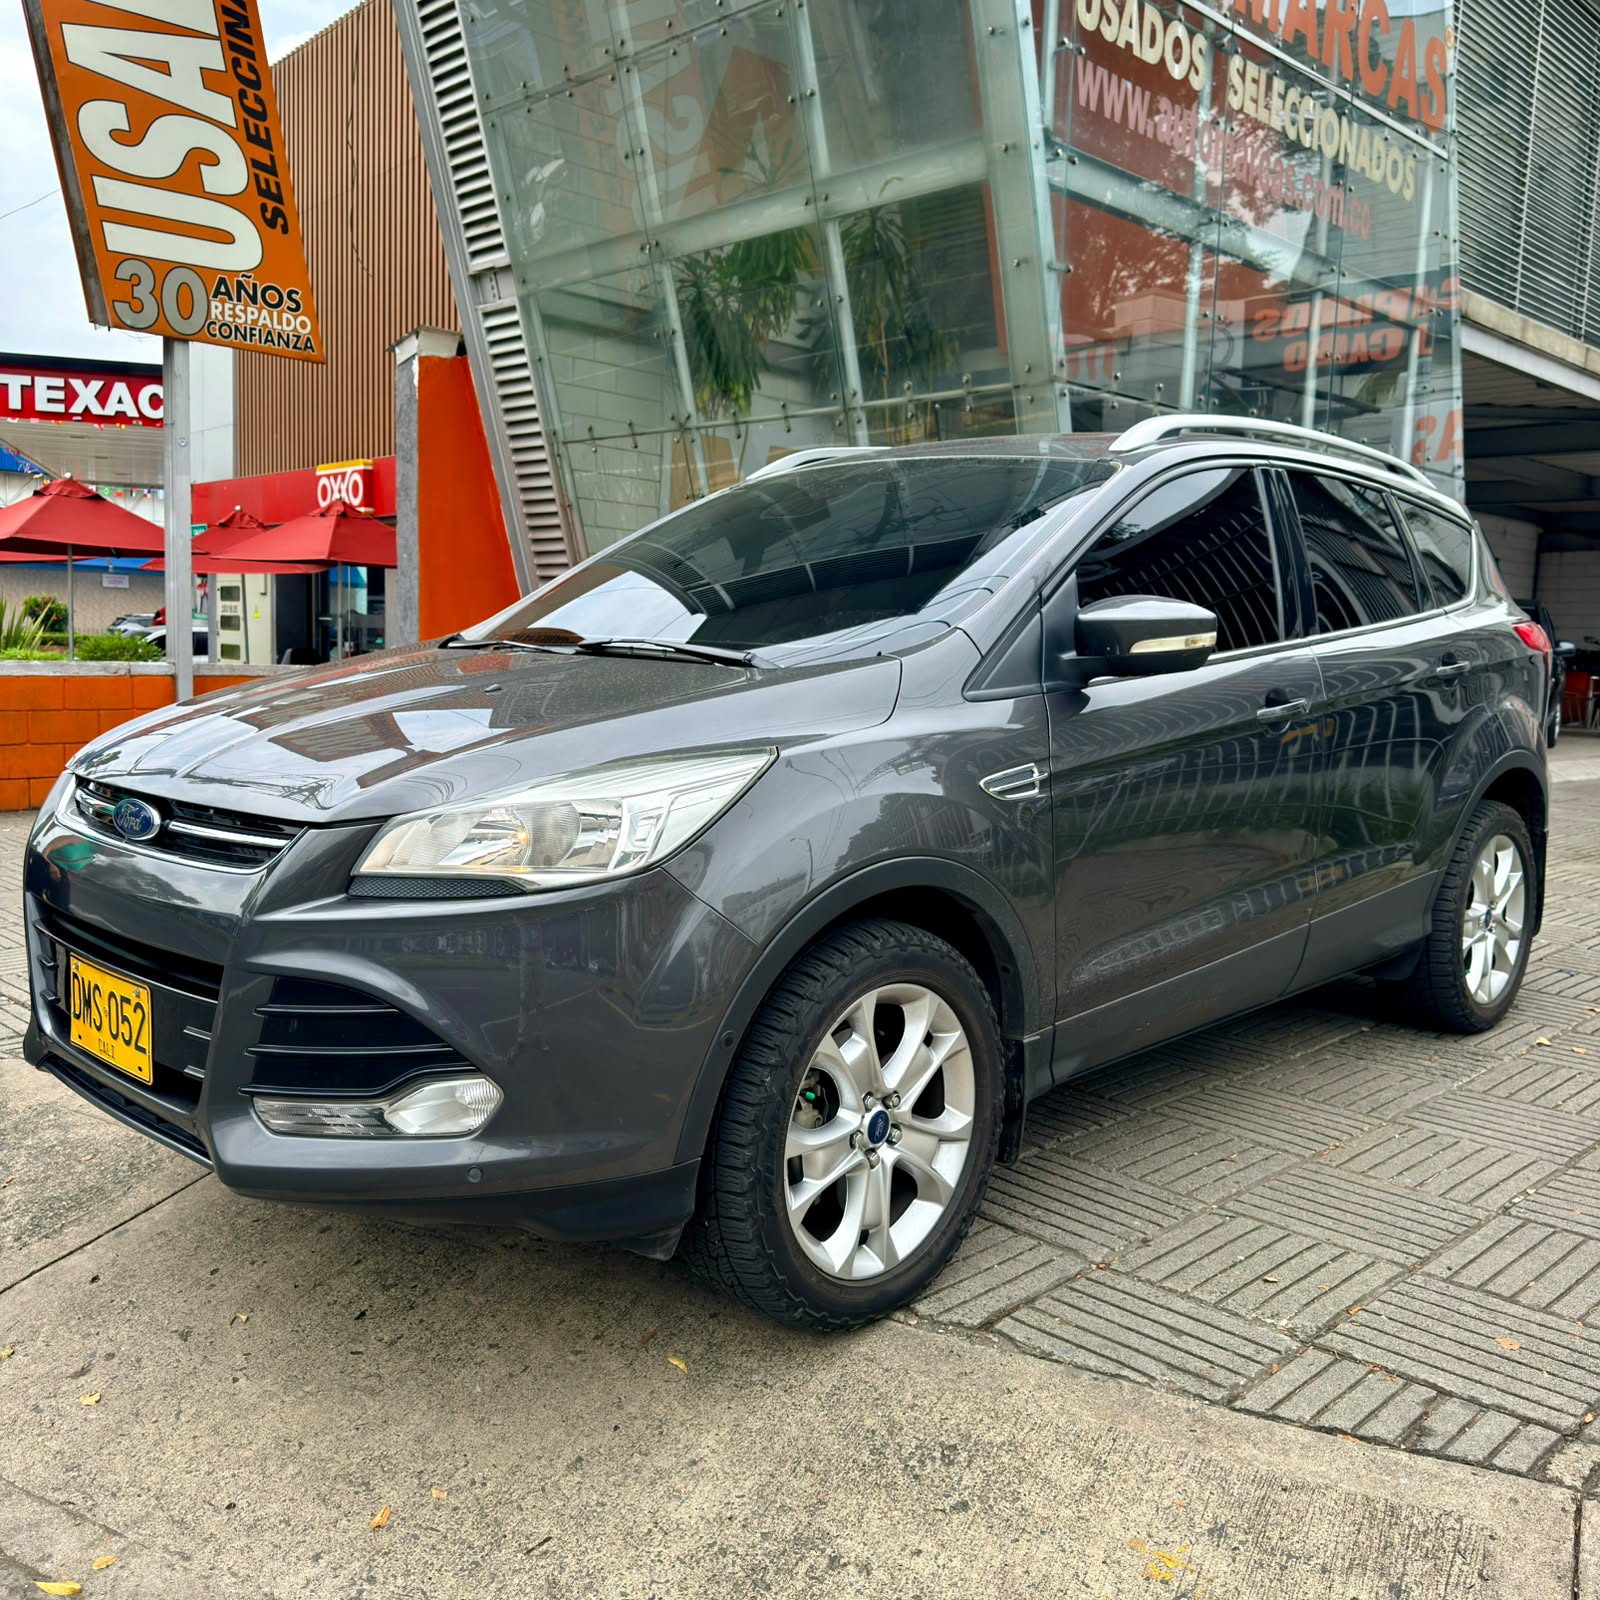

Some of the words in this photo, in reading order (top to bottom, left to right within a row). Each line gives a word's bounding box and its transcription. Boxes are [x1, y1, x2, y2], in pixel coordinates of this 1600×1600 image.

[1228, 54, 1416, 200] SELECCIONADOS
[112, 258, 209, 336] 30
[211, 272, 302, 314] AÑOS
[211, 301, 312, 335] RESPALDO
[206, 320, 316, 353] CONFIANZA
[317, 469, 363, 508] OXXO
[119, 803, 144, 831] Ford
[98, 1038, 116, 1059] CALI
